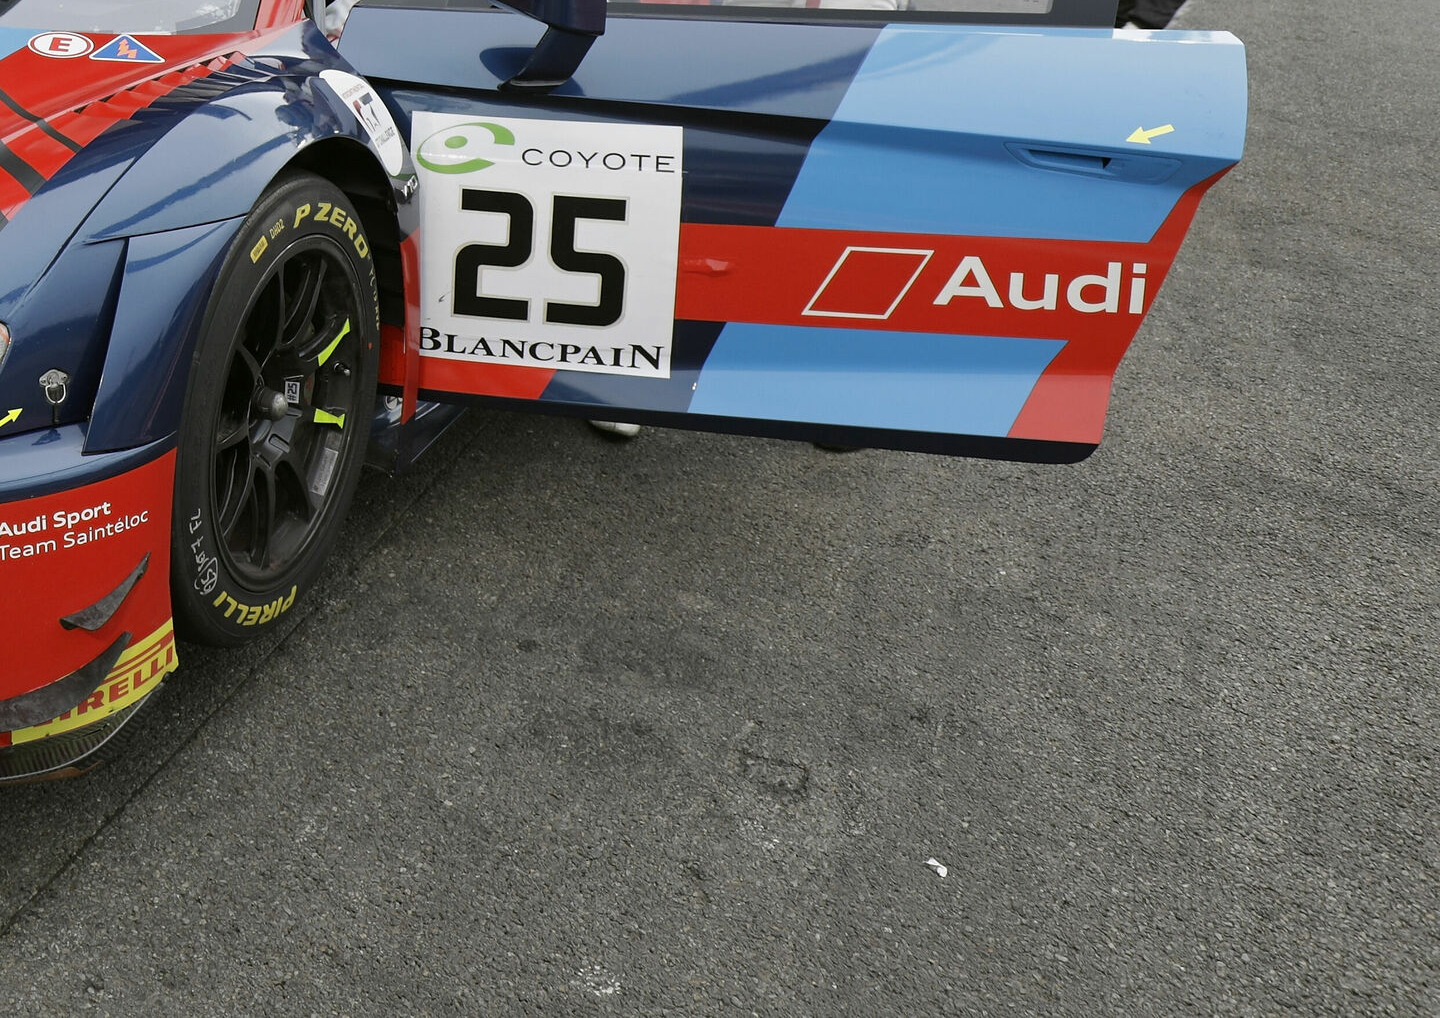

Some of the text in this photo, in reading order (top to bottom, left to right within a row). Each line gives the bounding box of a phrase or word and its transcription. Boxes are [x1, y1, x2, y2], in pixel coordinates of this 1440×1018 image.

[49, 37, 72, 52] E
[522, 148, 675, 173] COYOTE
[294, 203, 311, 229] P
[314, 202, 370, 259] ZERO
[454, 187, 628, 327] 25
[933, 256, 1147, 314] Audi
[419, 326, 664, 370] BLANCPAIN
[286, 381, 299, 403] #25
[53, 501, 112, 528] Sport
[63, 510, 149, 549] Saintéloc
[212, 584, 298, 626] PIRELLI
